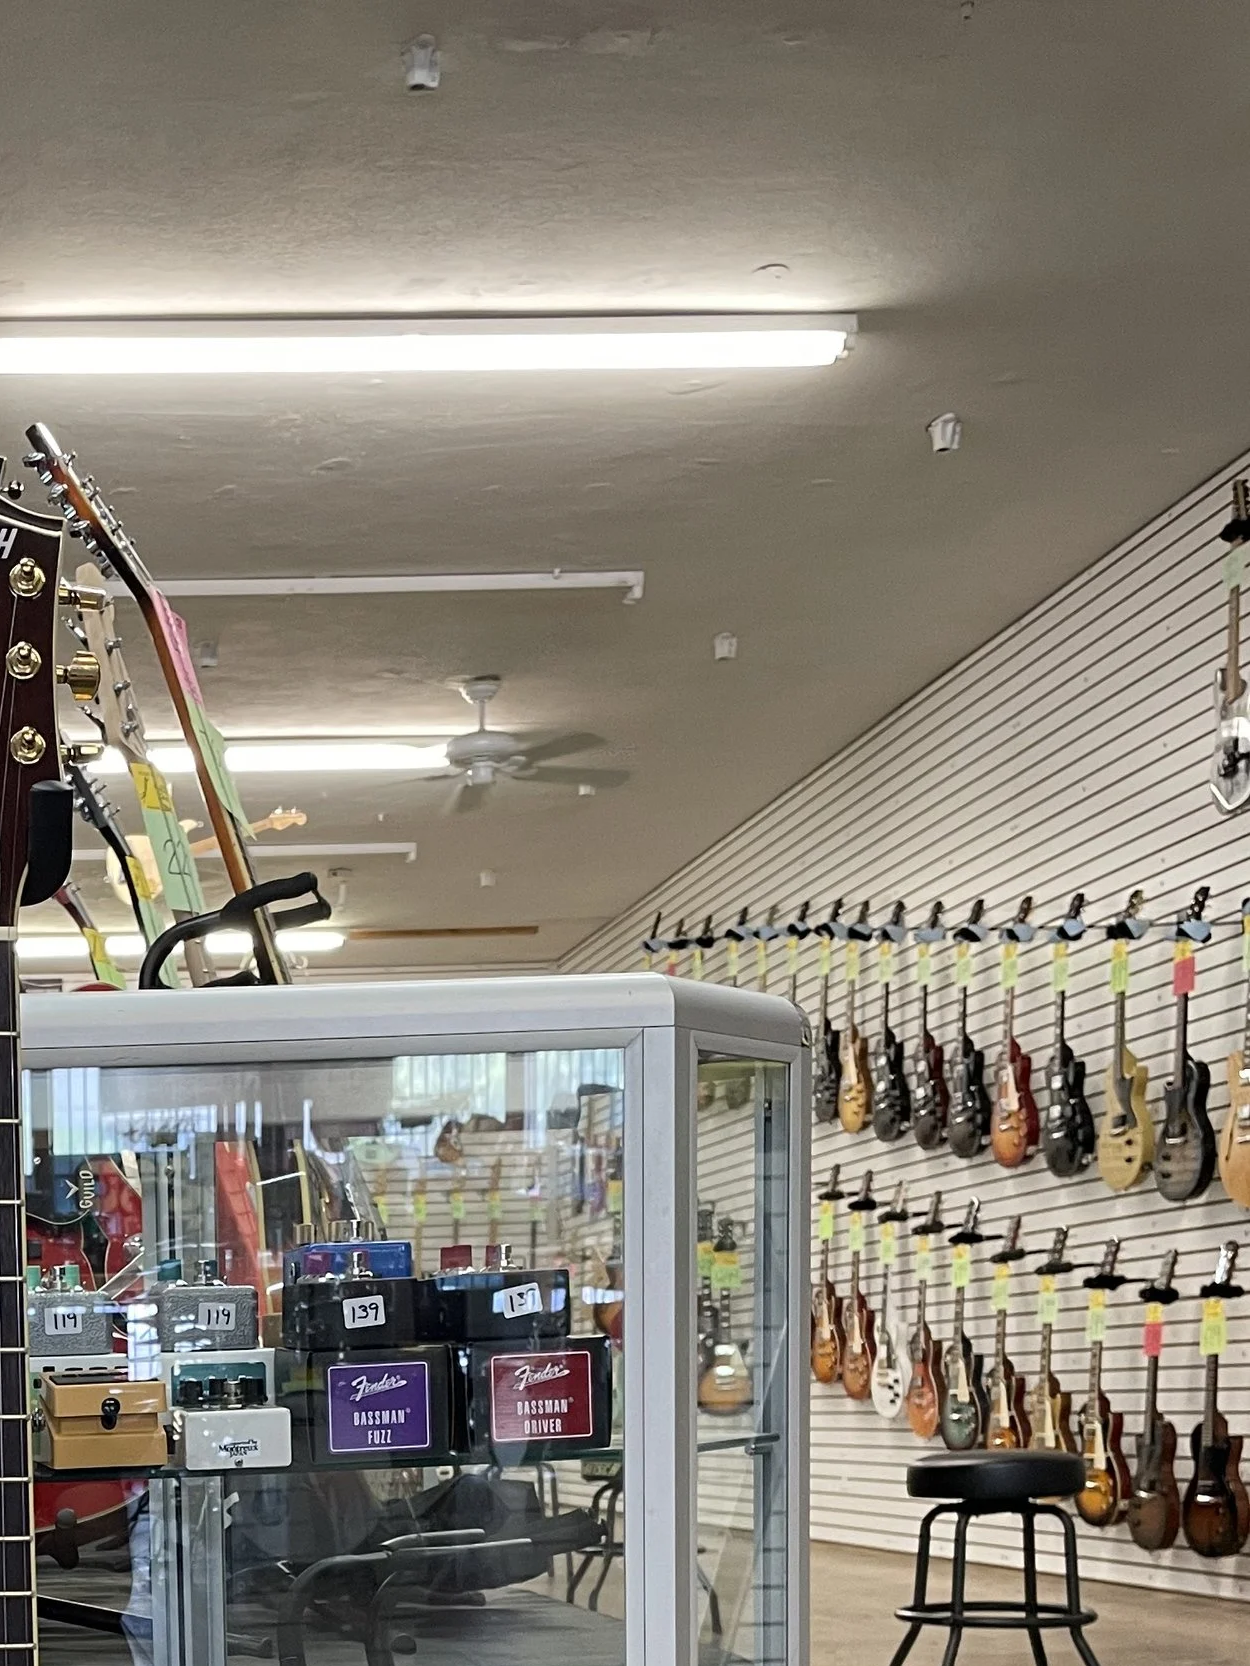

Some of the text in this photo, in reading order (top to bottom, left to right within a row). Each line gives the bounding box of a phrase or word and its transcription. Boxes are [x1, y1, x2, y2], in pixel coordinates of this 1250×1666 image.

[79, 1169, 95, 1210] GUILD
[53, 1312, 77, 1330] 119
[206, 1307, 231, 1326] 119
[351, 1302, 380, 1323] 139
[512, 1362, 571, 1391] Fender
[349, 1373, 408, 1402] Fender
[516, 1399, 568, 1416] BASSMAN
[353, 1409, 405, 1426] BASSMAN
[523, 1418, 562, 1434] DRIVER
[367, 1429, 392, 1445] FUZZ
